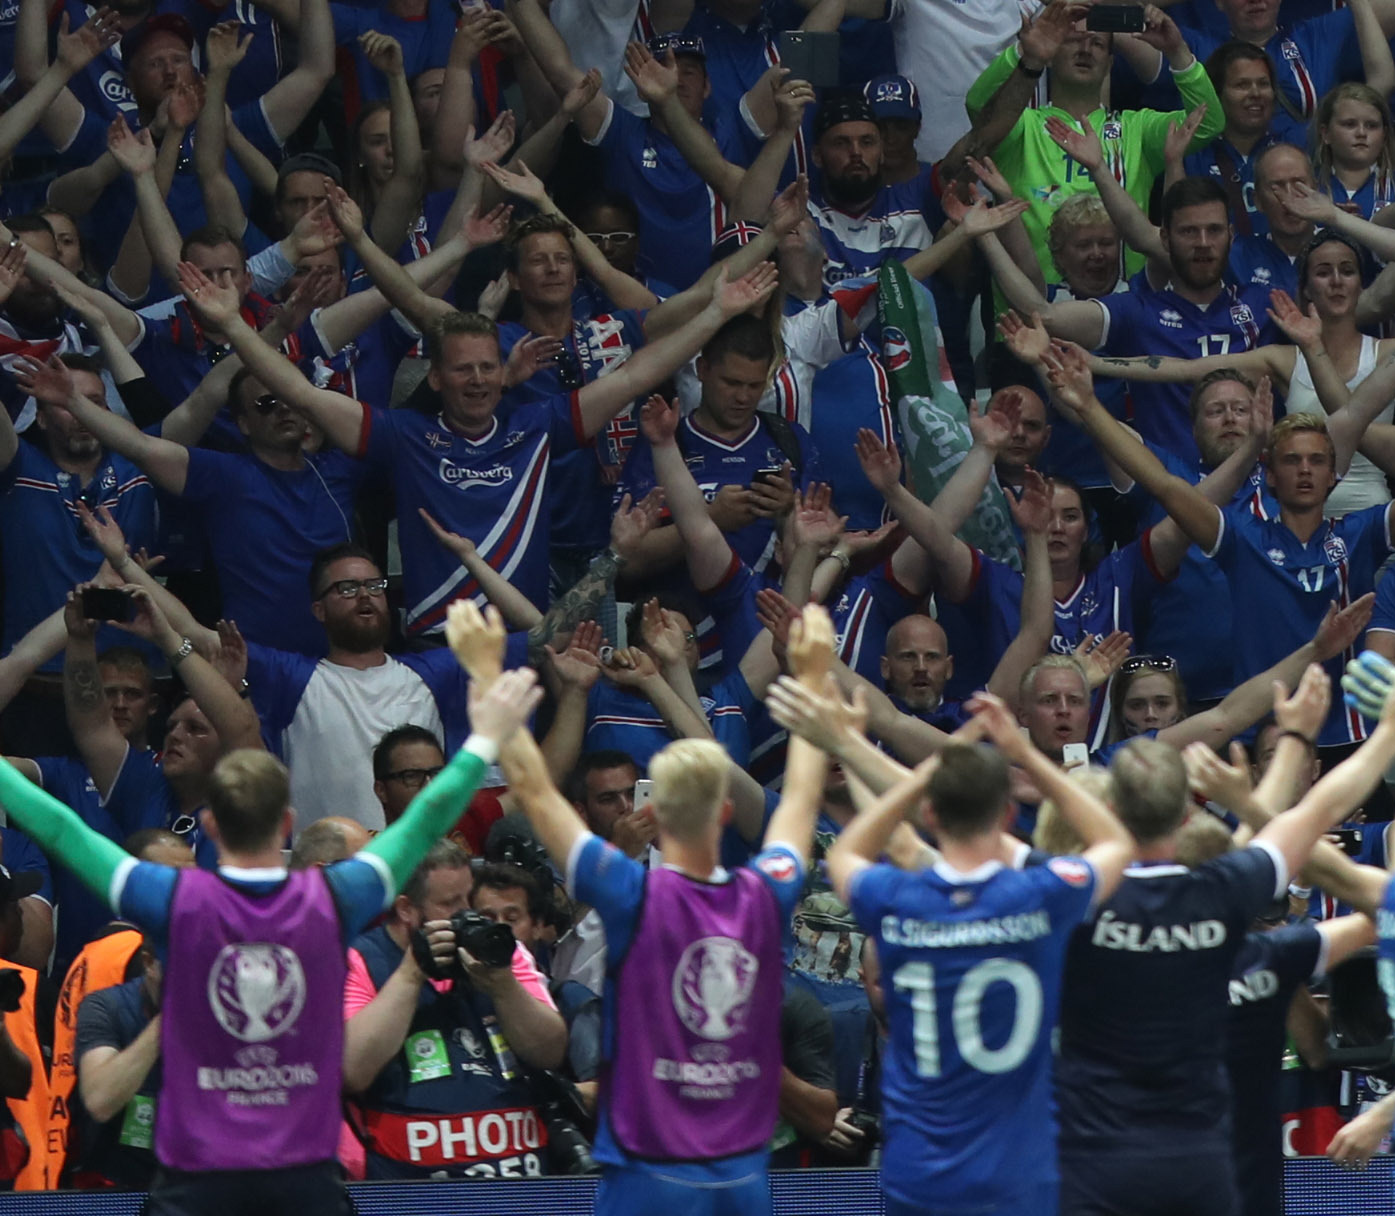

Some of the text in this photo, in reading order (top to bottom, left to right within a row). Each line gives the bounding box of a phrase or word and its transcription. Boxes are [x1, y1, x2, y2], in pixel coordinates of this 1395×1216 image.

[1195, 333, 1231, 355] 17
[438, 457, 514, 486] Carlsberg
[1296, 565, 1324, 593] 17
[1091, 907, 1228, 954] ÍSLAND
[891, 957, 1045, 1079] 10
[405, 1110, 541, 1162] PHOTO
